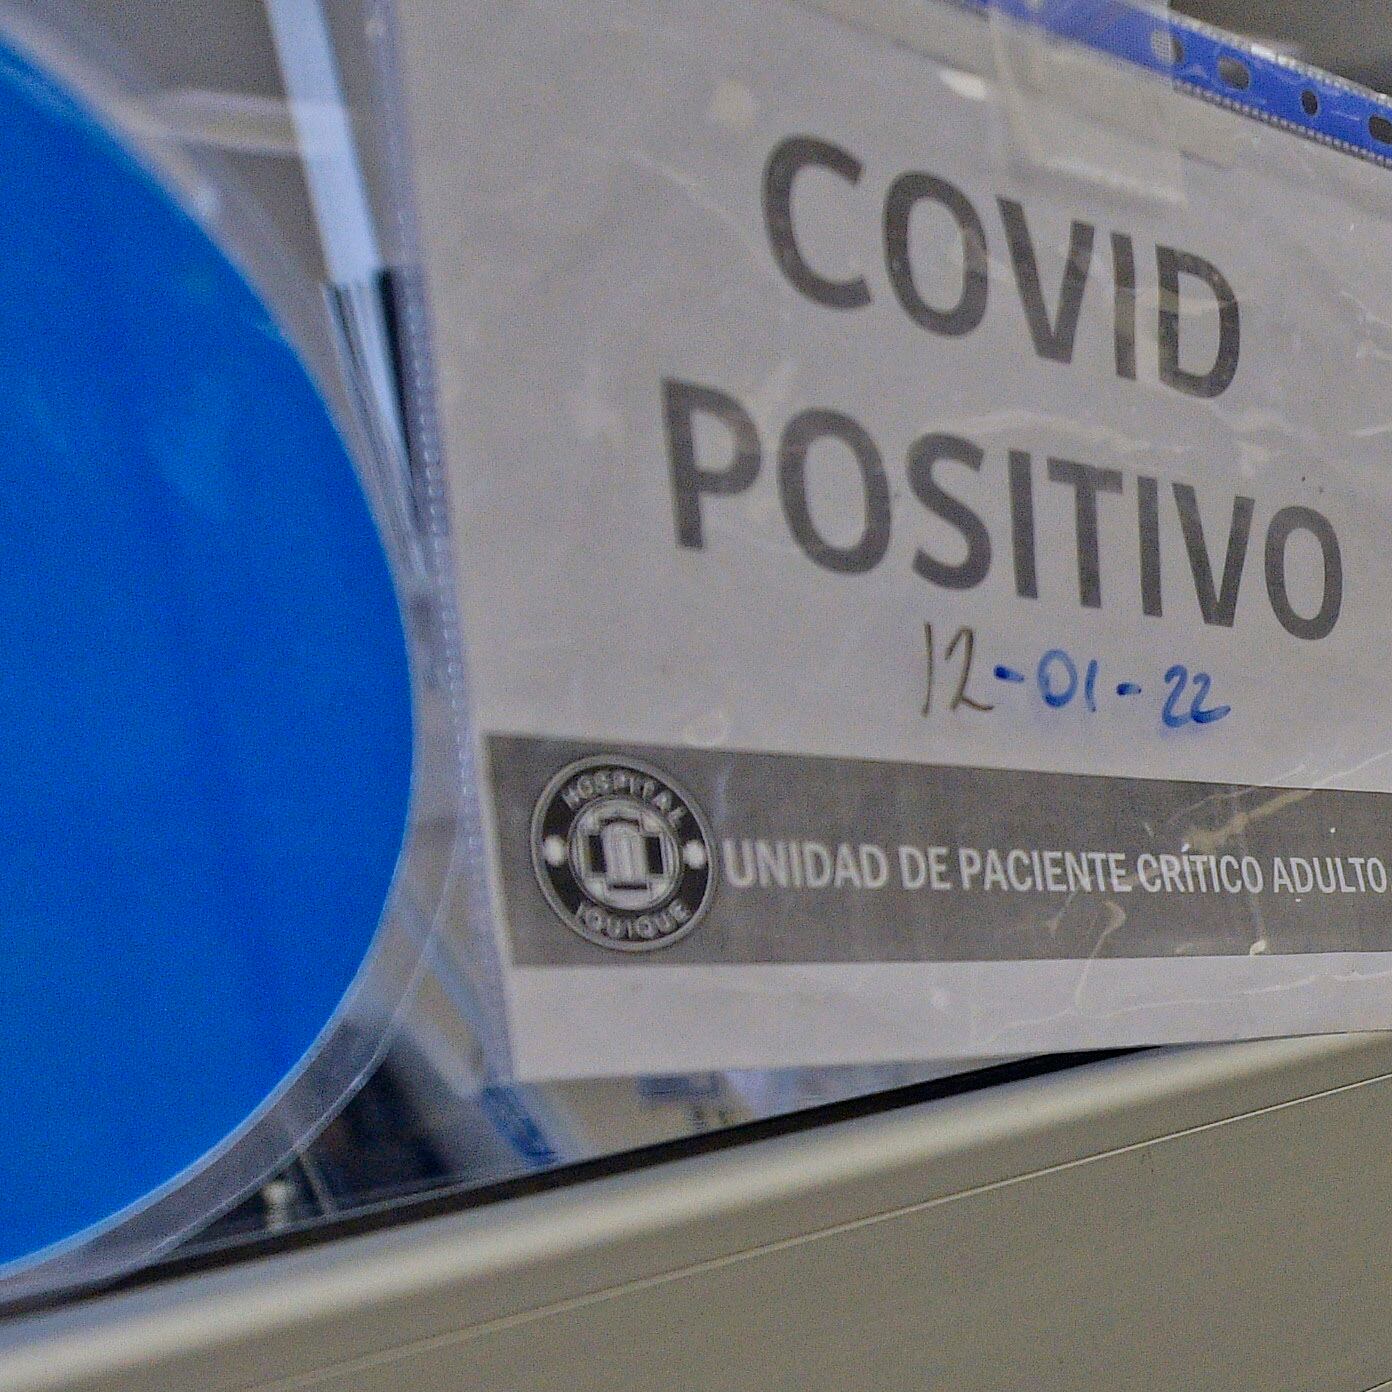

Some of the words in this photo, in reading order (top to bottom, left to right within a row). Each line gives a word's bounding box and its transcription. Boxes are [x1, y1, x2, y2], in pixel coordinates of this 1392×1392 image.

[761, 134, 1240, 398] COVID
[661, 376, 1344, 640] POSITIVO
[921, 622, 1231, 729] 12-01-22
[561, 770, 687, 826] HOSPITAL
[721, 838, 890, 890] UNIDAD
[901, 845, 951, 891] DE
[958, 847, 1133, 893] PACIENTE
[1136, 843, 1264, 894] CRÍTICO
[574, 900, 692, 940] IQUIQUE
